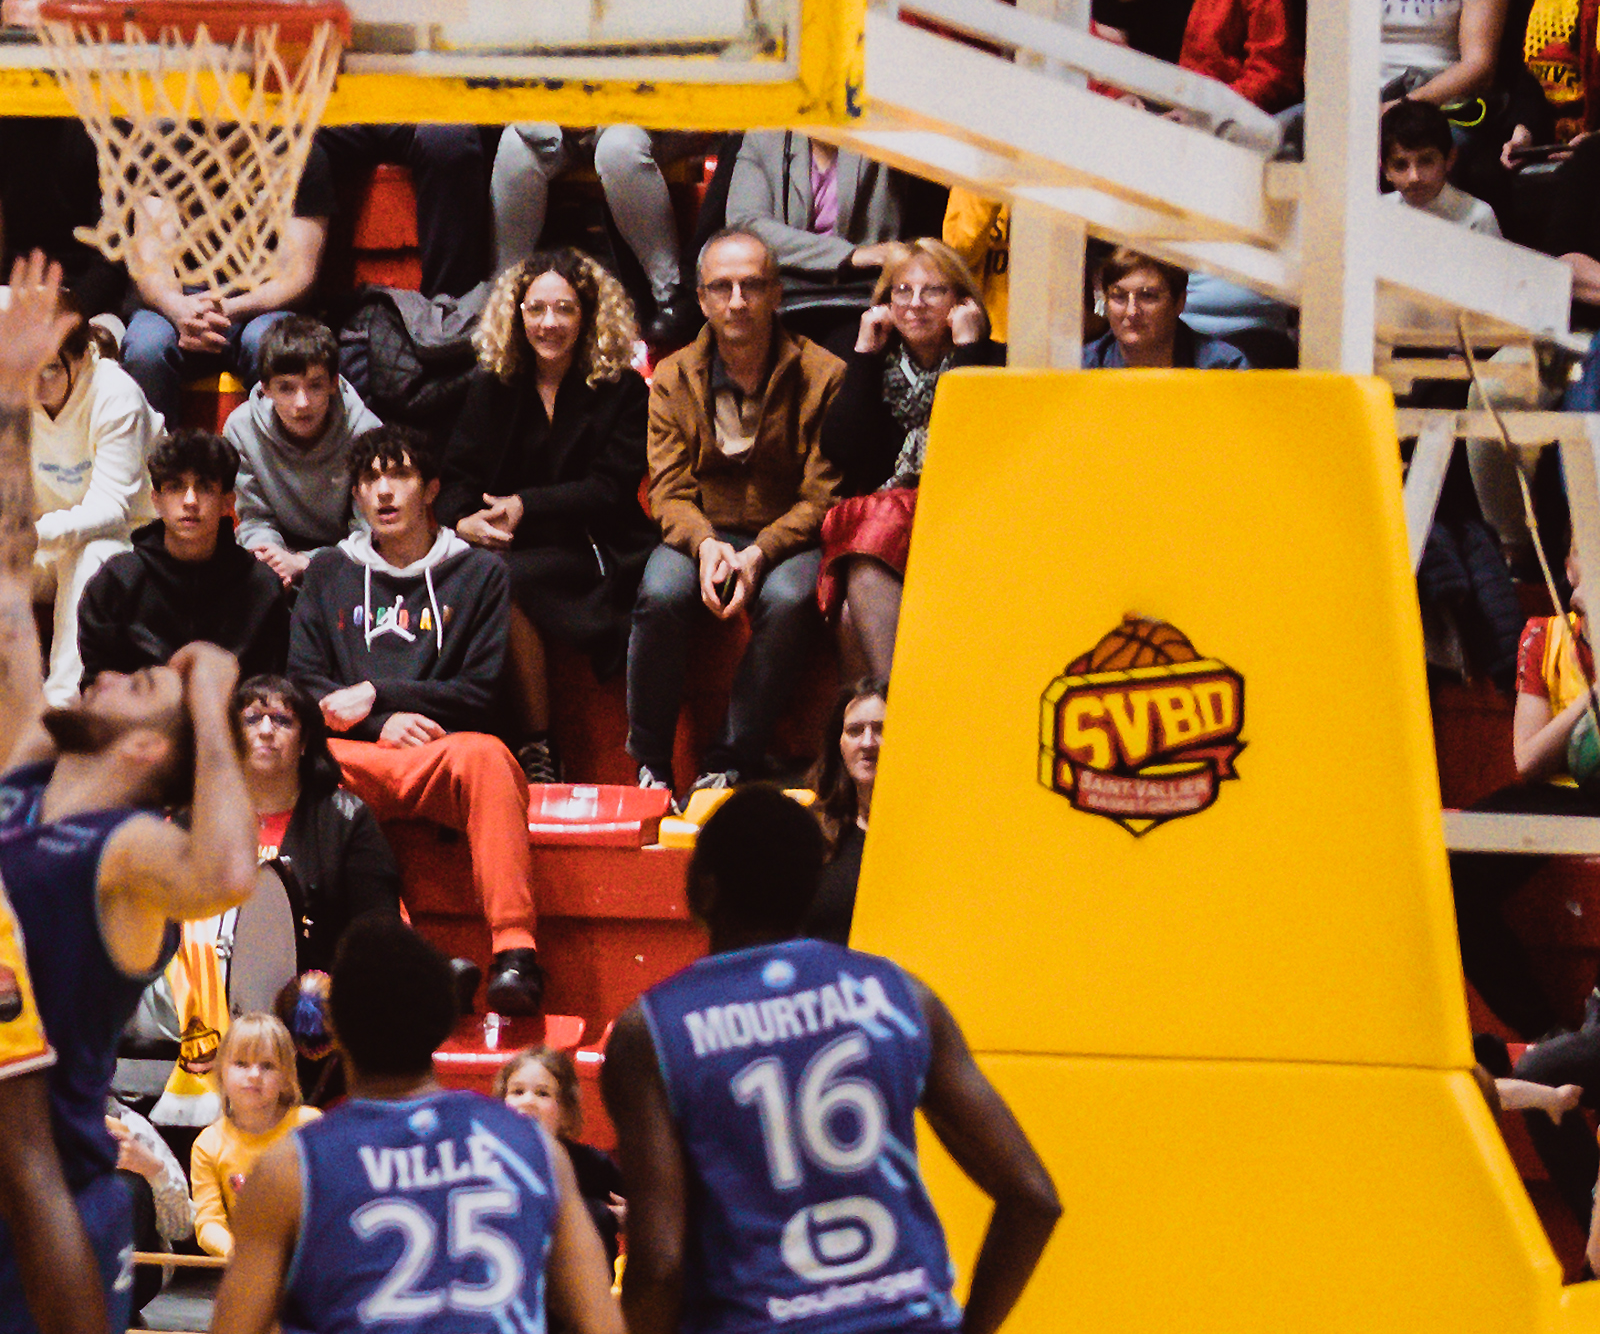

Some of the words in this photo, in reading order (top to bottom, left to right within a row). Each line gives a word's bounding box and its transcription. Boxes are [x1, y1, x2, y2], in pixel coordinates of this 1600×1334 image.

[1063, 680, 1235, 769] SVBD
[731, 1030, 888, 1190] 16
[349, 1185, 527, 1325] 25
